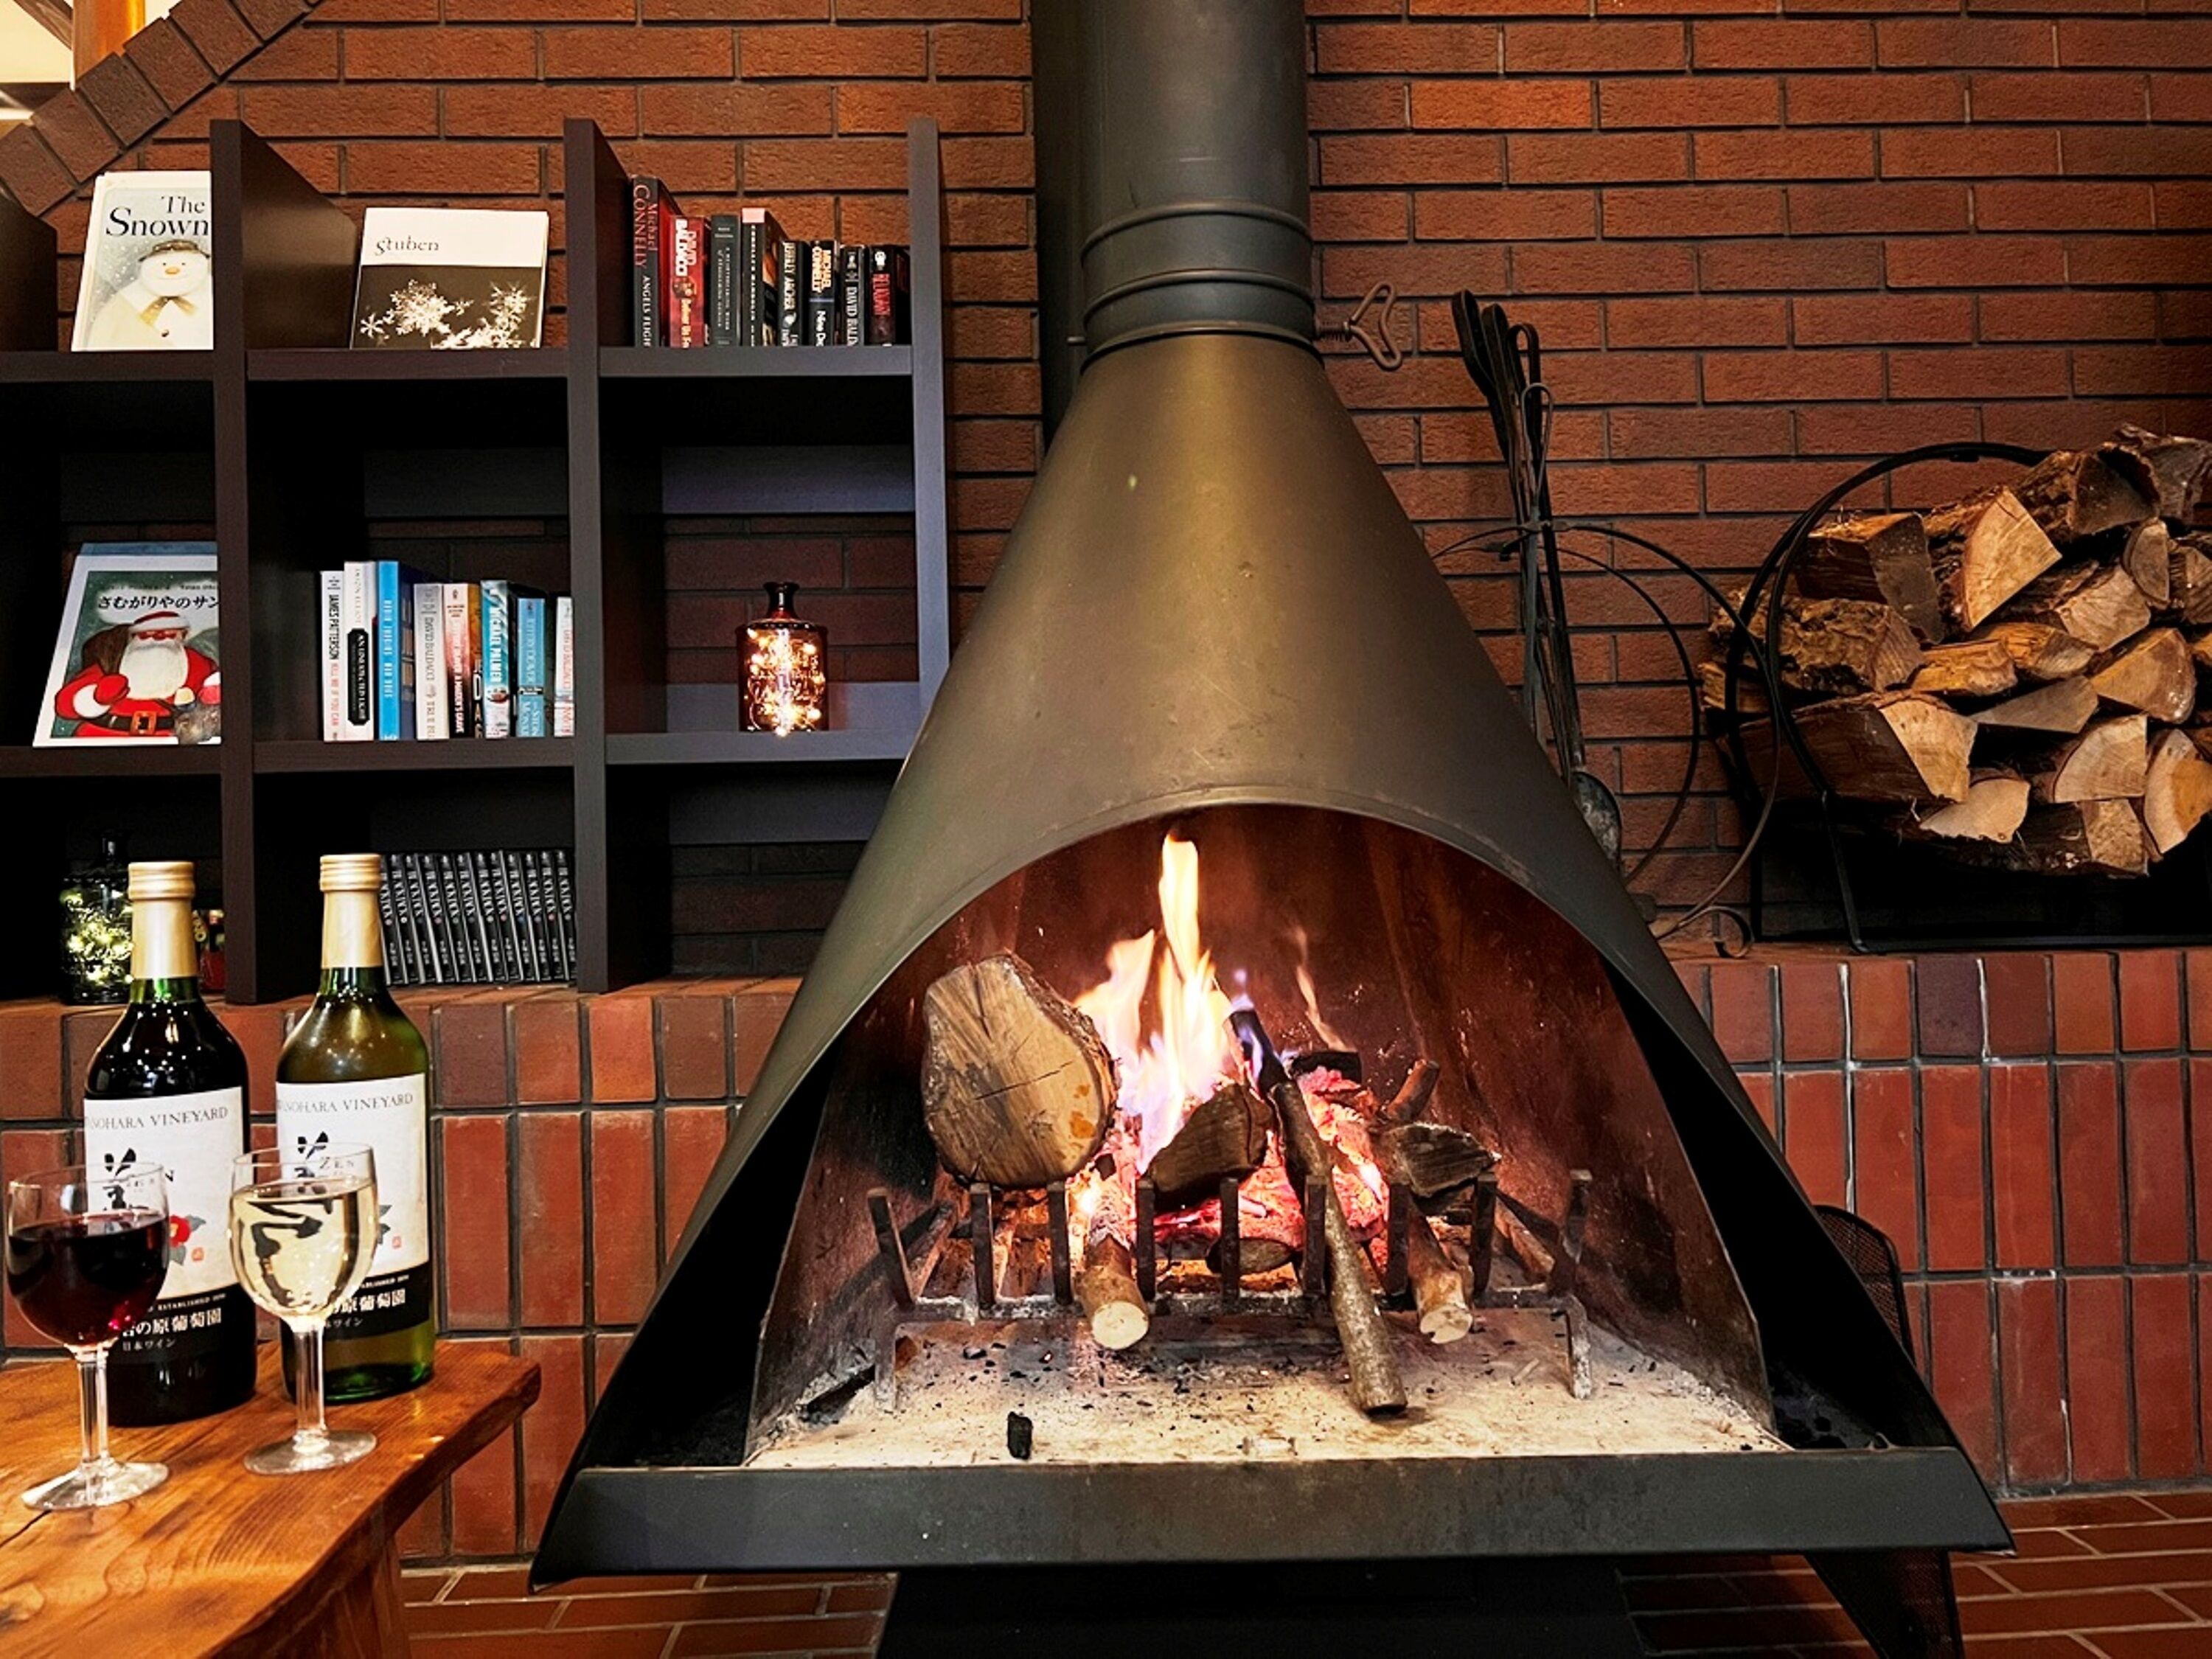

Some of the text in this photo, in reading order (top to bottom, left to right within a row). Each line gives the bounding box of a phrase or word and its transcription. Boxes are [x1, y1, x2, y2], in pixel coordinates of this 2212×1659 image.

[161, 195, 205, 214] The
[633, 184, 650, 269] CONNELLY
[647, 202, 658, 251] Michael
[675, 219, 688, 276] BALDACCI
[686, 230, 697, 265] DAVID
[642, 275, 652, 313] ANGELS
[98, 595, 220, 609] さむがりやのサン
[328, 594, 340, 618] JAMES
[328, 618, 340, 660] PATTERSON
[490, 647, 502, 682] PALMER
[150, 1107, 229, 1127] VINEYARD
[343, 1093, 414, 1110] VINEYARD
